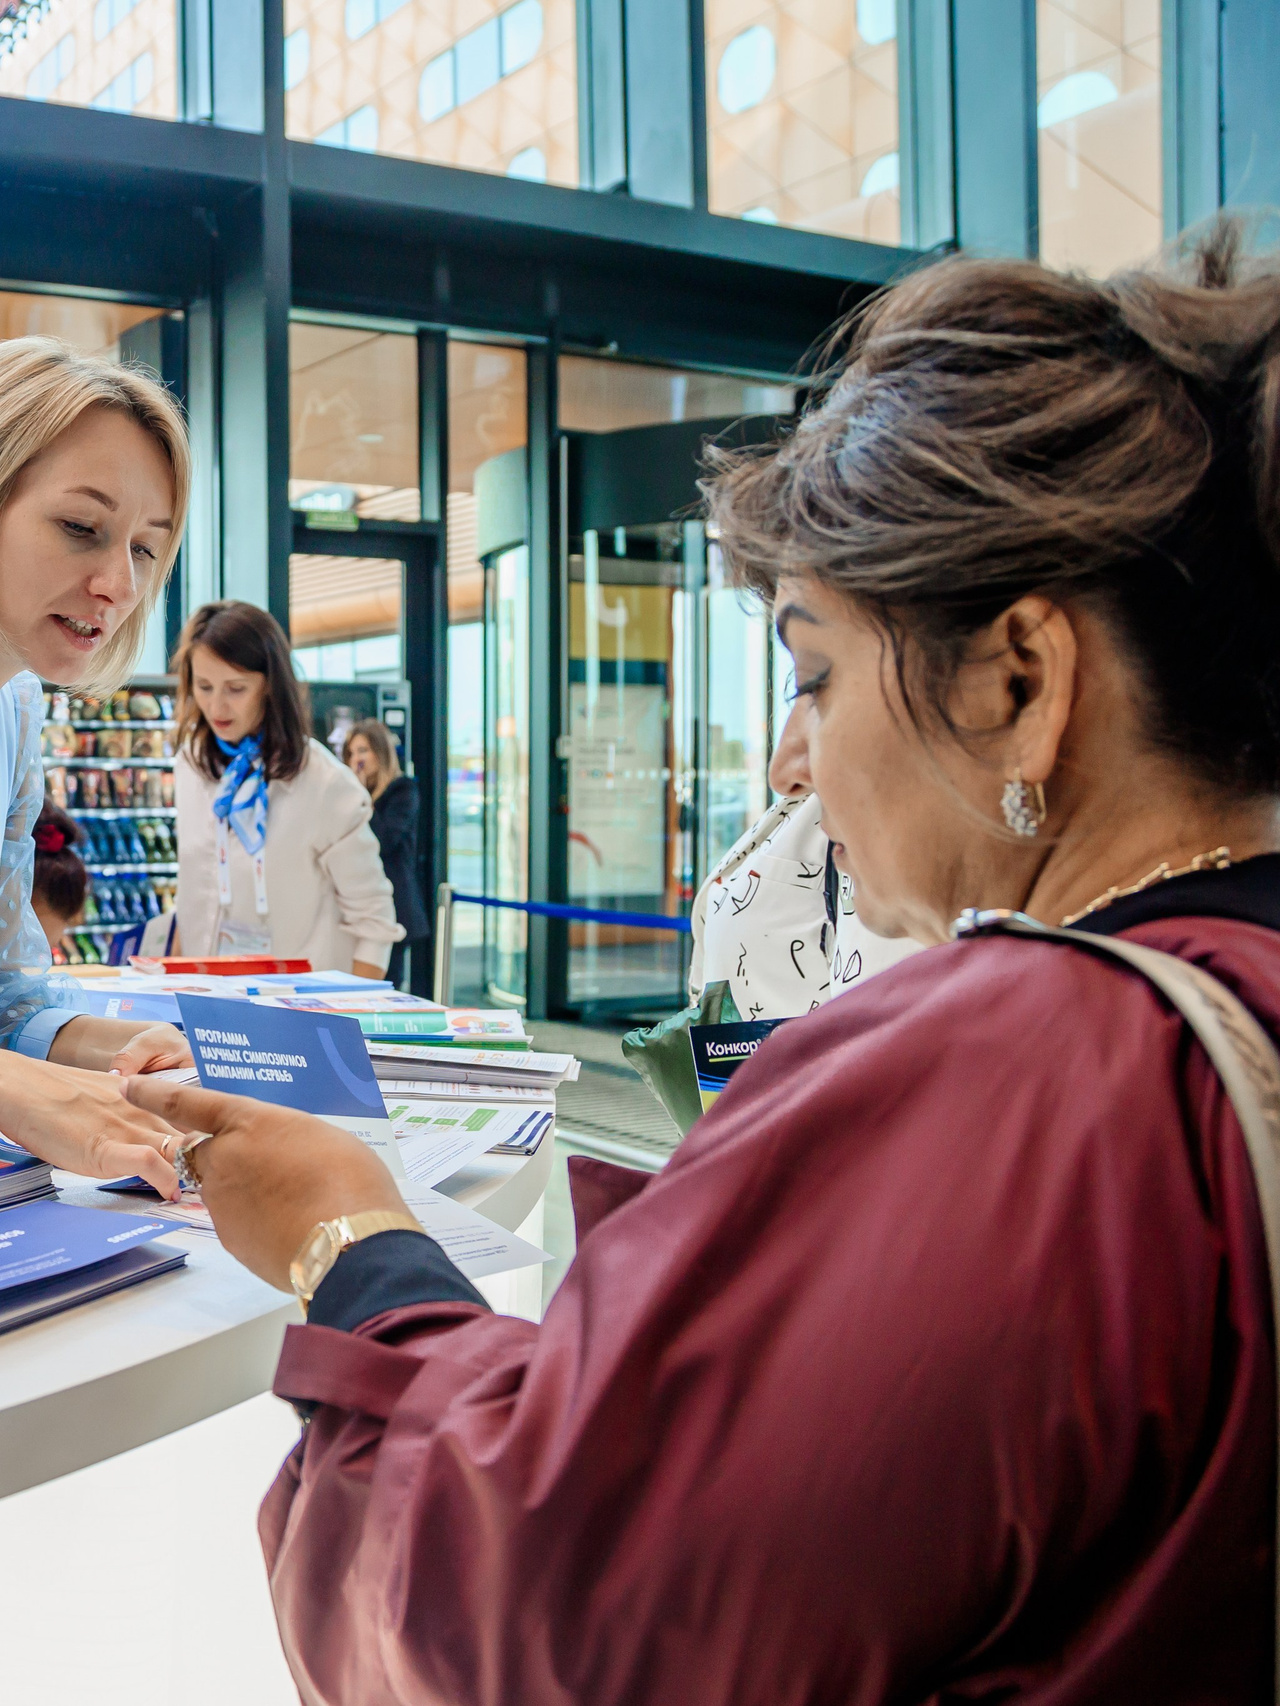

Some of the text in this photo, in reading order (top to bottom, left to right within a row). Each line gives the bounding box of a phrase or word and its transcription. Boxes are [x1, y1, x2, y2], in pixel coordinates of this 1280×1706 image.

[194, 1027, 251, 1047] ПРОГРАММА
[199, 1045, 308, 1068] НАУЧНЫХ СИМПОЗИУМОВ
[204, 1063, 294, 1083] КОМПАНИИ «СЕРВЬЕ»
[106, 1224, 164, 1244] SERVIER
